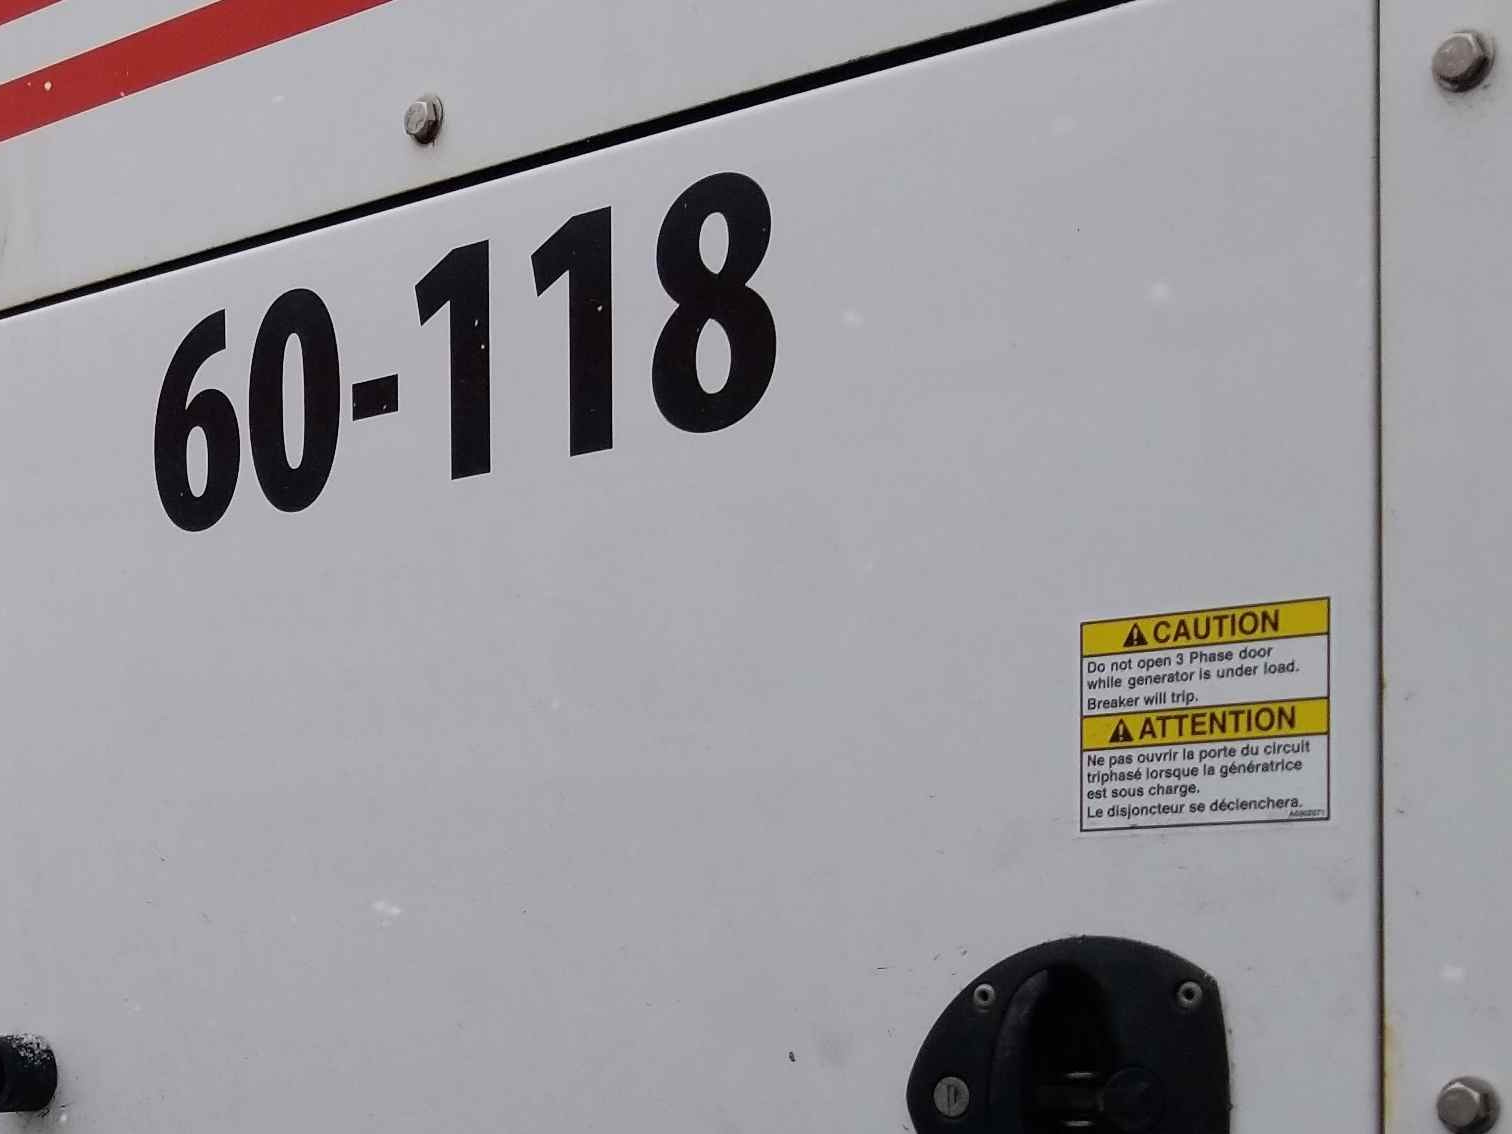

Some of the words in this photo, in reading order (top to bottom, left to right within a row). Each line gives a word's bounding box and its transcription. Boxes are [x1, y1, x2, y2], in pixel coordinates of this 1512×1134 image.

[153, 171, 777, 532] 60-118
[1153, 609, 1279, 643] CAUTION
[1087, 661, 1106, 673] Do
[1110, 659, 1133, 672] not
[1137, 656, 1172, 671] open
[1176, 653, 1184, 665] 3
[1189, 649, 1234, 664] Phase
[1238, 647, 1273, 659] door
[1087, 676, 1122, 690] while
[1127, 671, 1195, 689] generator
[1199, 668, 1211, 680] is
[1216, 663, 1258, 678] under
[1263, 660, 1300, 675] load.
[1087, 695, 1140, 711] Breaker
[1143, 691, 1167, 706] will
[1171, 690, 1199, 706] trip.
[1139, 706, 1295, 740] ATTENTION
[1087, 754, 1105, 767] Ne
[1109, 754, 1133, 768] pas
[1137, 749, 1179, 763] ouvrir
[1182, 748, 1195, 760] la
[1199, 746, 1237, 762] porte
[1240, 744, 1260, 757] du
[1263, 740, 1311, 756] circuit
[1087, 768, 1142, 785] triphasé
[1146, 766, 1199, 780] lorsque
[1203, 764, 1215, 776] la
[1219, 758, 1303, 778] génératrice
[1087, 787, 1108, 800] est
[1111, 786, 1145, 798] sous
[1148, 783, 1200, 798] charge.
[1087, 806, 1104, 818] Le
[1107, 803, 1186, 820] disjoncteur
[1189, 802, 1206, 813] se
[1209, 797, 1303, 812] déclenchera.
